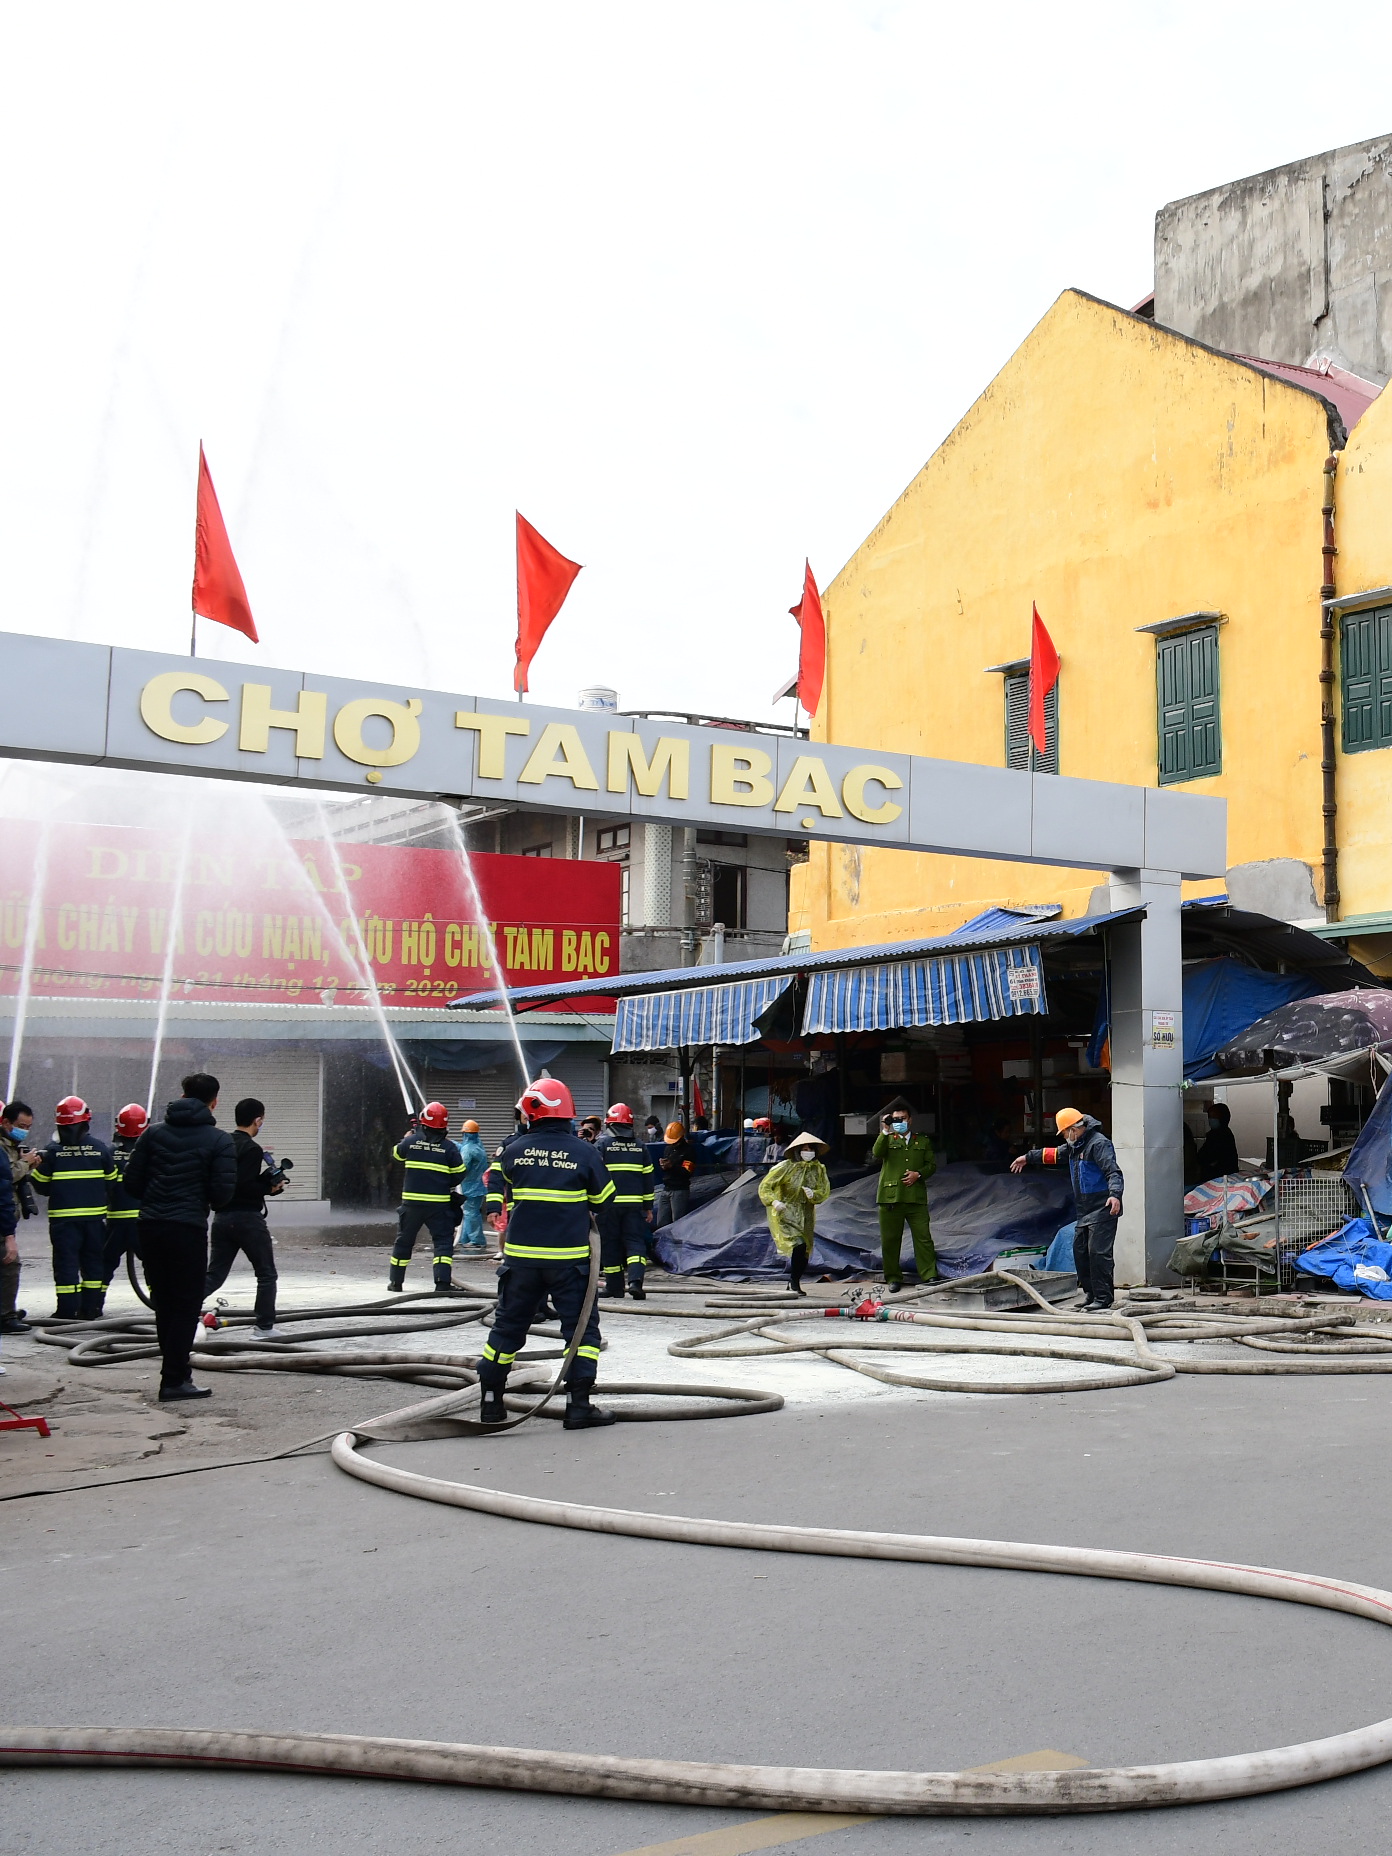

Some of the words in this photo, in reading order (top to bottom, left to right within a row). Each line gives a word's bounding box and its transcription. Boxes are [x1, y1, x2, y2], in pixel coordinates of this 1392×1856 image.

[140, 671, 423, 784] CHỢ
[454, 711, 690, 800] TAM
[710, 743, 904, 829] BẠC
[57, 895, 140, 953] CHÁY
[196, 901, 254, 958] CỨU
[262, 913, 330, 970] NẠN,
[401, 912, 437, 976] HỘ
[444, 919, 498, 978] CHỢ
[503, 925, 554, 971] TAM
[561, 929, 610, 980] BẠC
[404, 979, 459, 998] 2020
[523, 1147, 549, 1157] CẢNH
[550, 1150, 570, 1159] SÁT
[513, 1157, 535, 1166] PCCC
[538, 1157, 550, 1167] VÀ
[552, 1160, 578, 1170] CNCH
